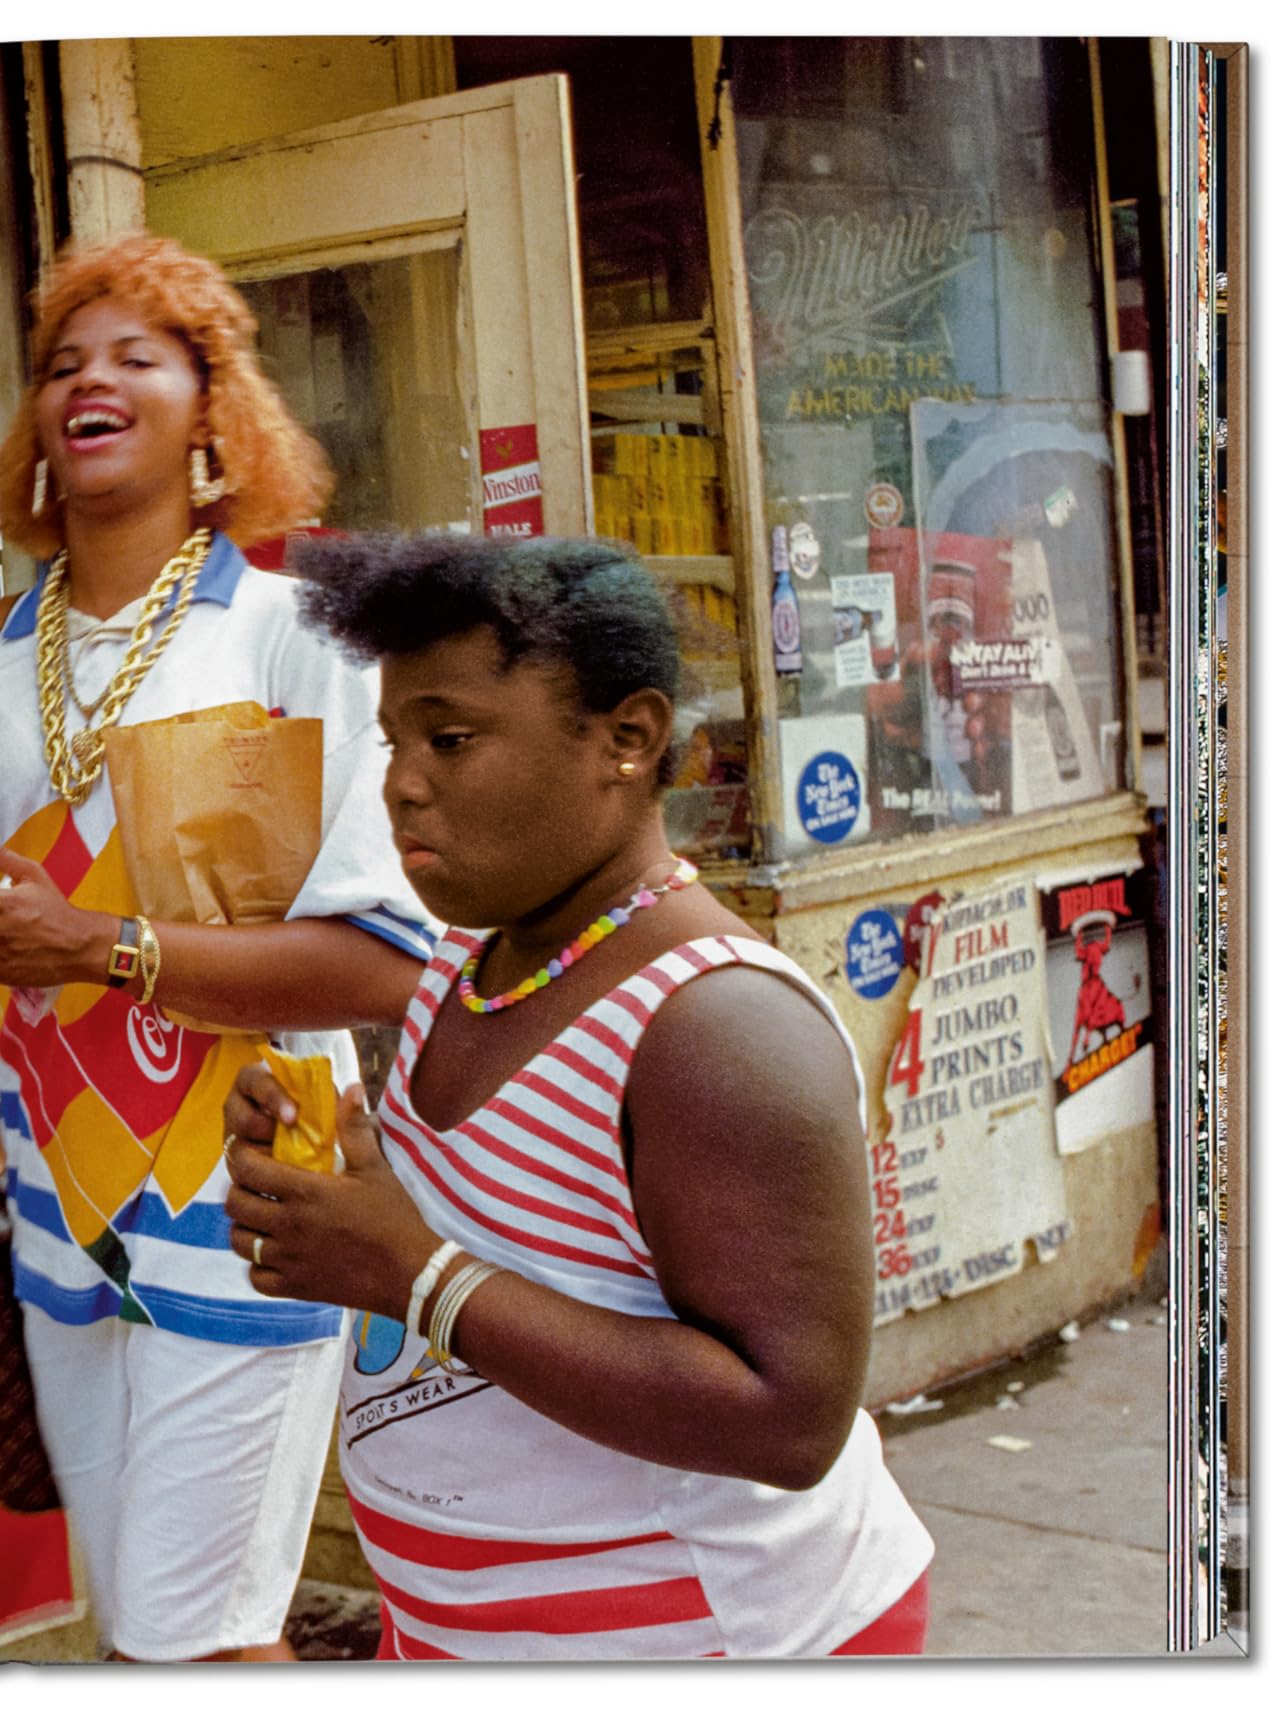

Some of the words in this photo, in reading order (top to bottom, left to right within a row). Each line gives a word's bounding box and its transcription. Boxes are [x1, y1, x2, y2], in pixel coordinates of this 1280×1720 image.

[954, 920, 1009, 965] FILM
[933, 948, 1036, 999] DEVELOPED
[931, 994, 1019, 1045] JUMBO
[891, 1008, 924, 1098] 4
[931, 1031, 1023, 1085] PRINTS
[900, 1088, 961, 1133] EXTRA
[969, 1057, 1044, 1110] CHARGE
[871, 1142, 897, 1175] 12
[873, 1177, 901, 1209] 15
[873, 1209, 908, 1244] 24
[878, 1244, 913, 1280] 36
[963, 1241, 1018, 1282] DISC
[405, 1377, 456, 1405] WEAR
